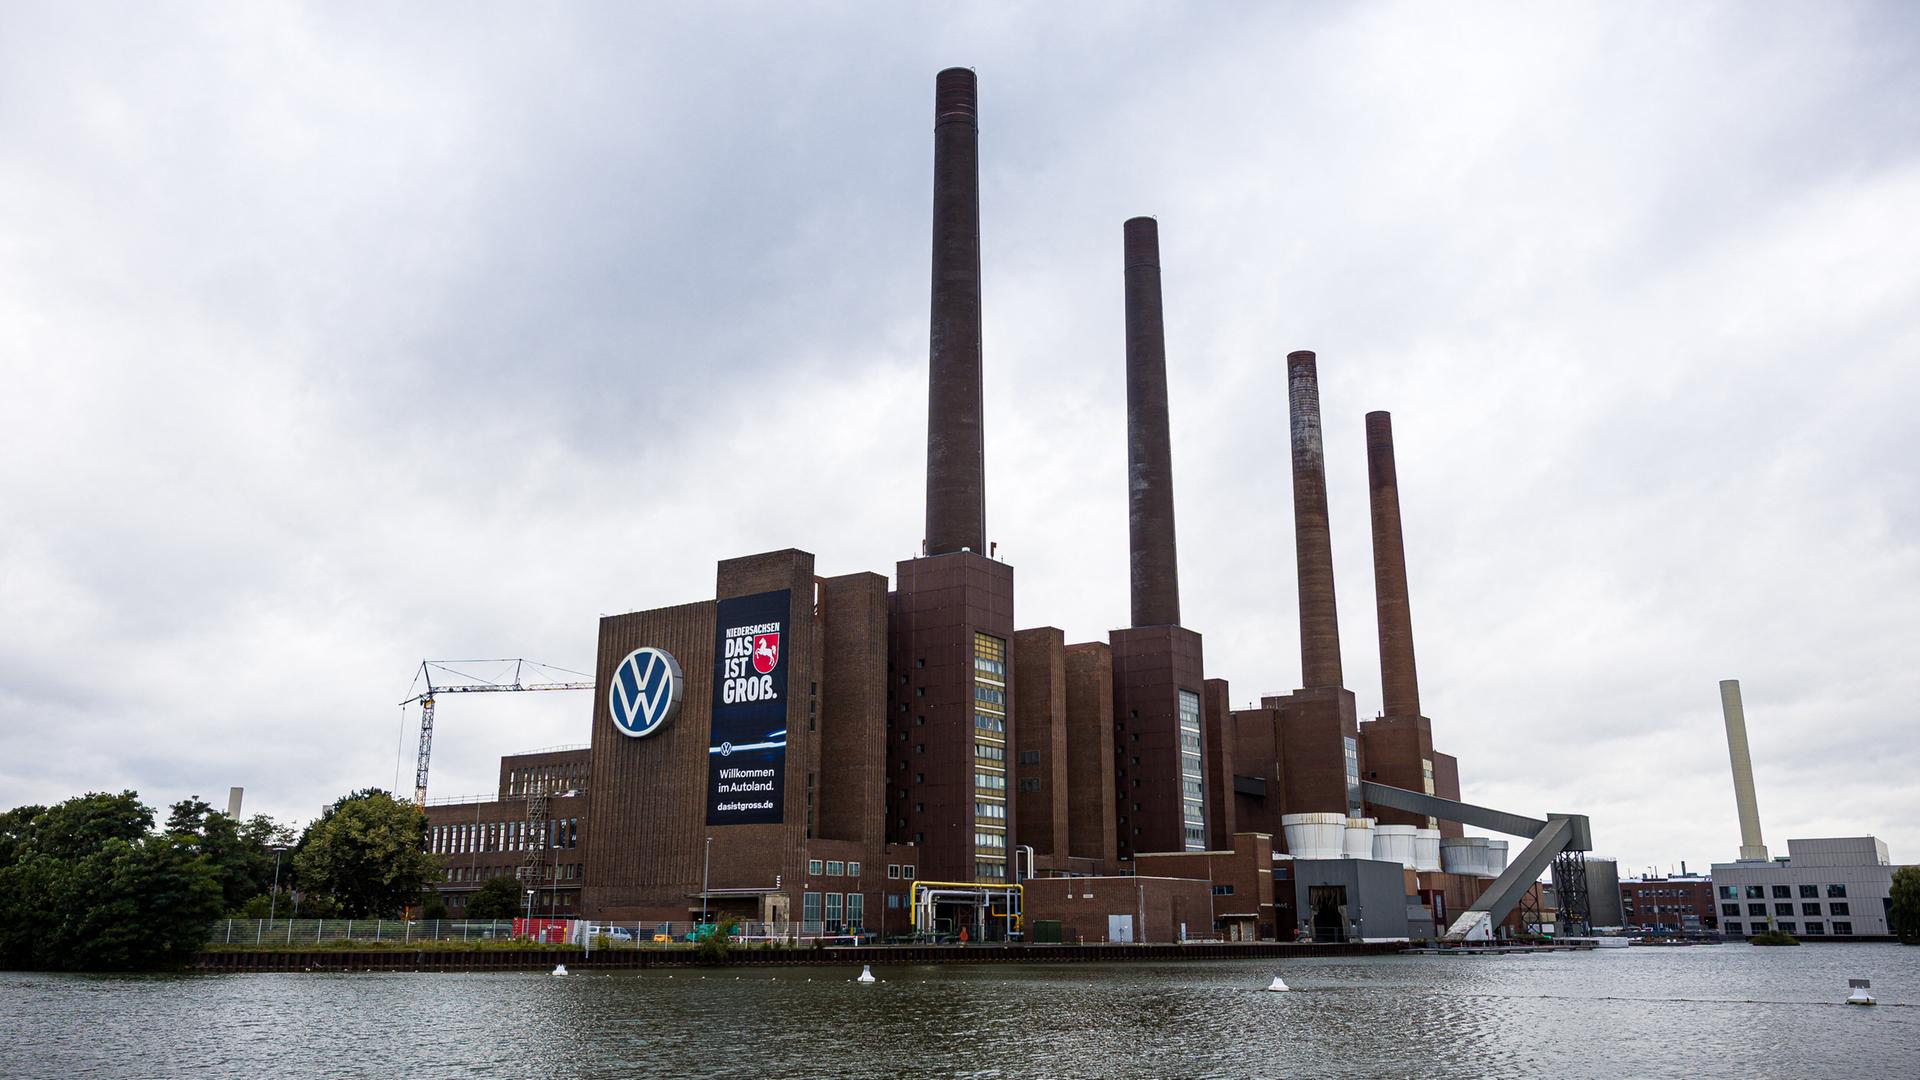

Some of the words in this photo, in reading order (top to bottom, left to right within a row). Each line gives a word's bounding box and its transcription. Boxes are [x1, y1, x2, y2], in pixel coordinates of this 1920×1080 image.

[726, 622, 780, 638] NIEDERSACHSEN
[725, 636, 753, 658] DAS
[724, 657, 749, 679] IST
[610, 649, 672, 733] VW
[719, 768, 775, 779] Willkommen
[718, 782, 730, 793] im
[730, 780, 774, 792] Autoland.
[717, 800, 774, 811] dasistgross.de
